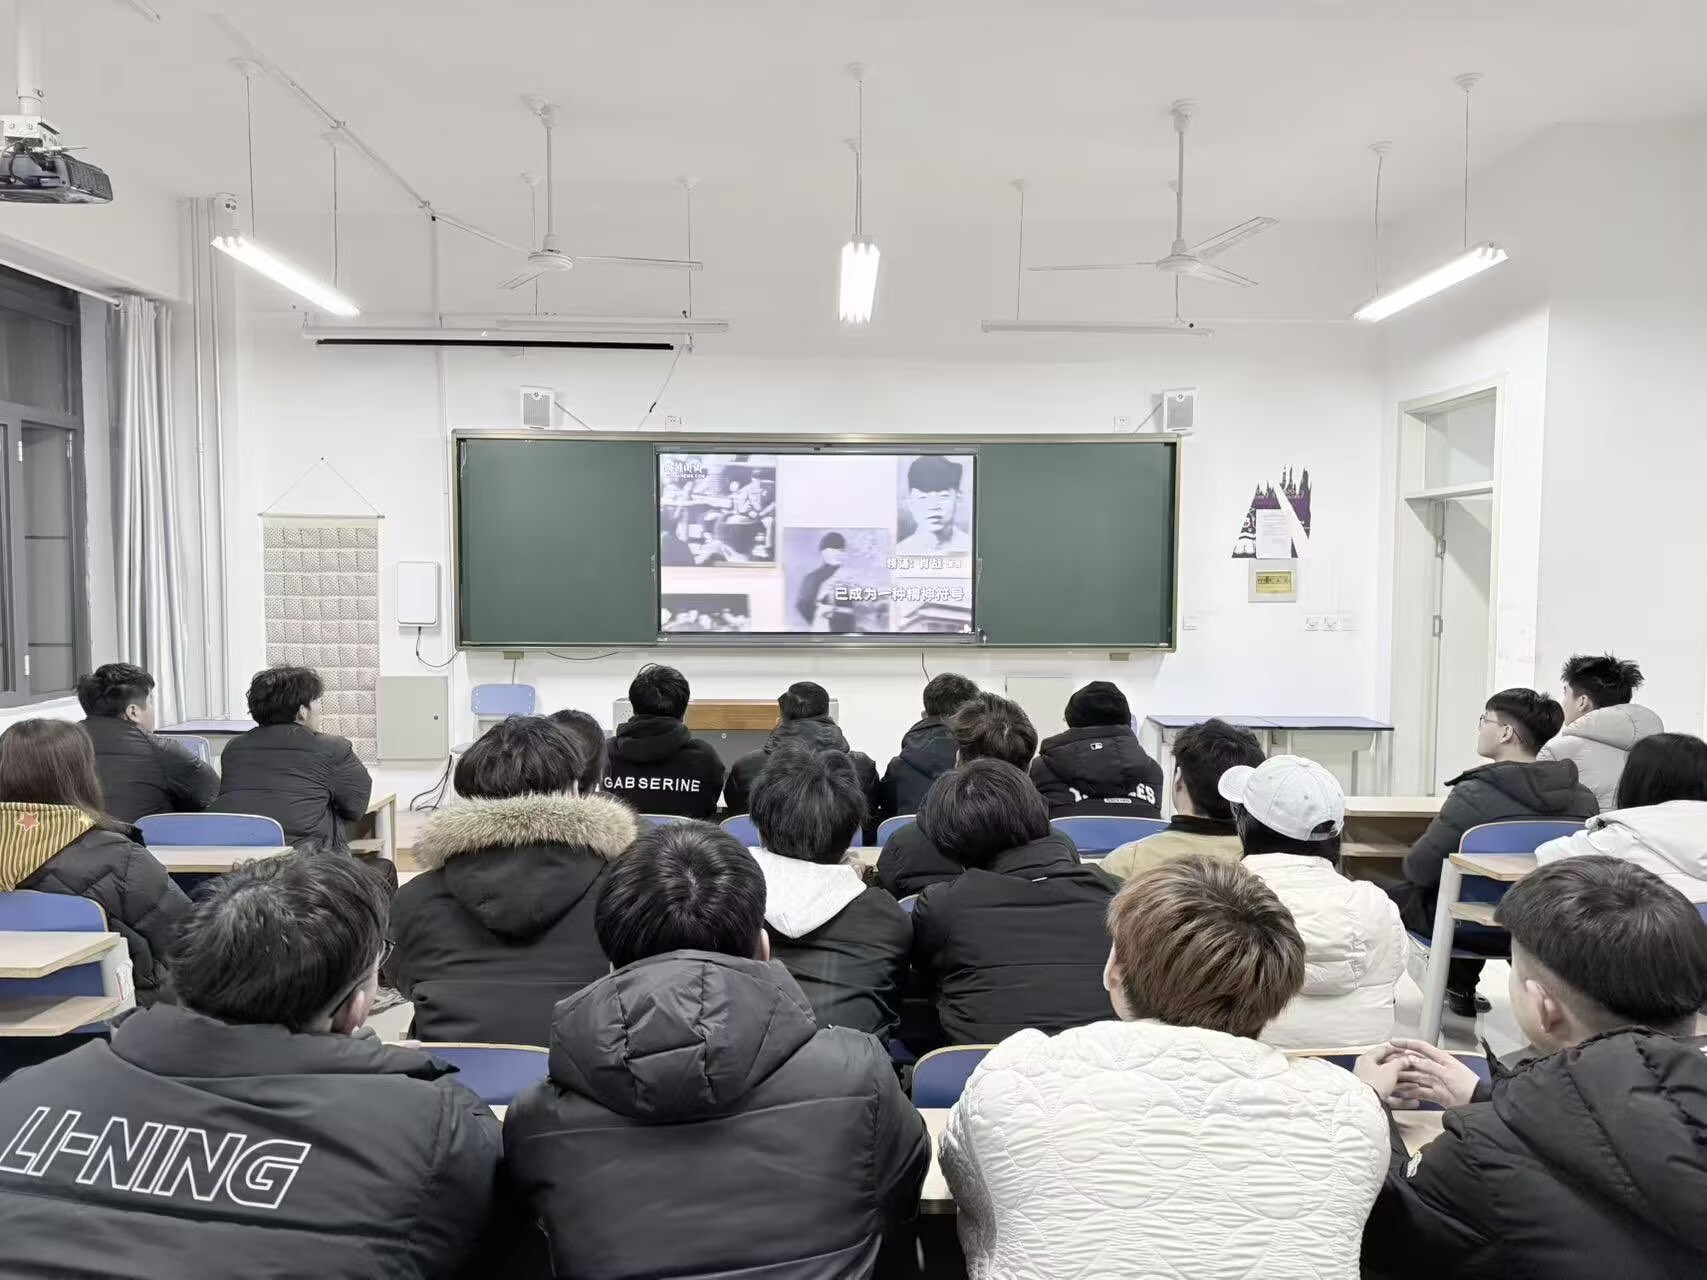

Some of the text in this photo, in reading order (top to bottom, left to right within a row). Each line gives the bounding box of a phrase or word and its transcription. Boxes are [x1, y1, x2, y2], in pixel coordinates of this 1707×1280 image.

[835, 587, 964, 601] 已成为一种精神符号
[603, 776, 701, 792] GABSERINE
[0, 1106, 312, 1209] LI-NING
